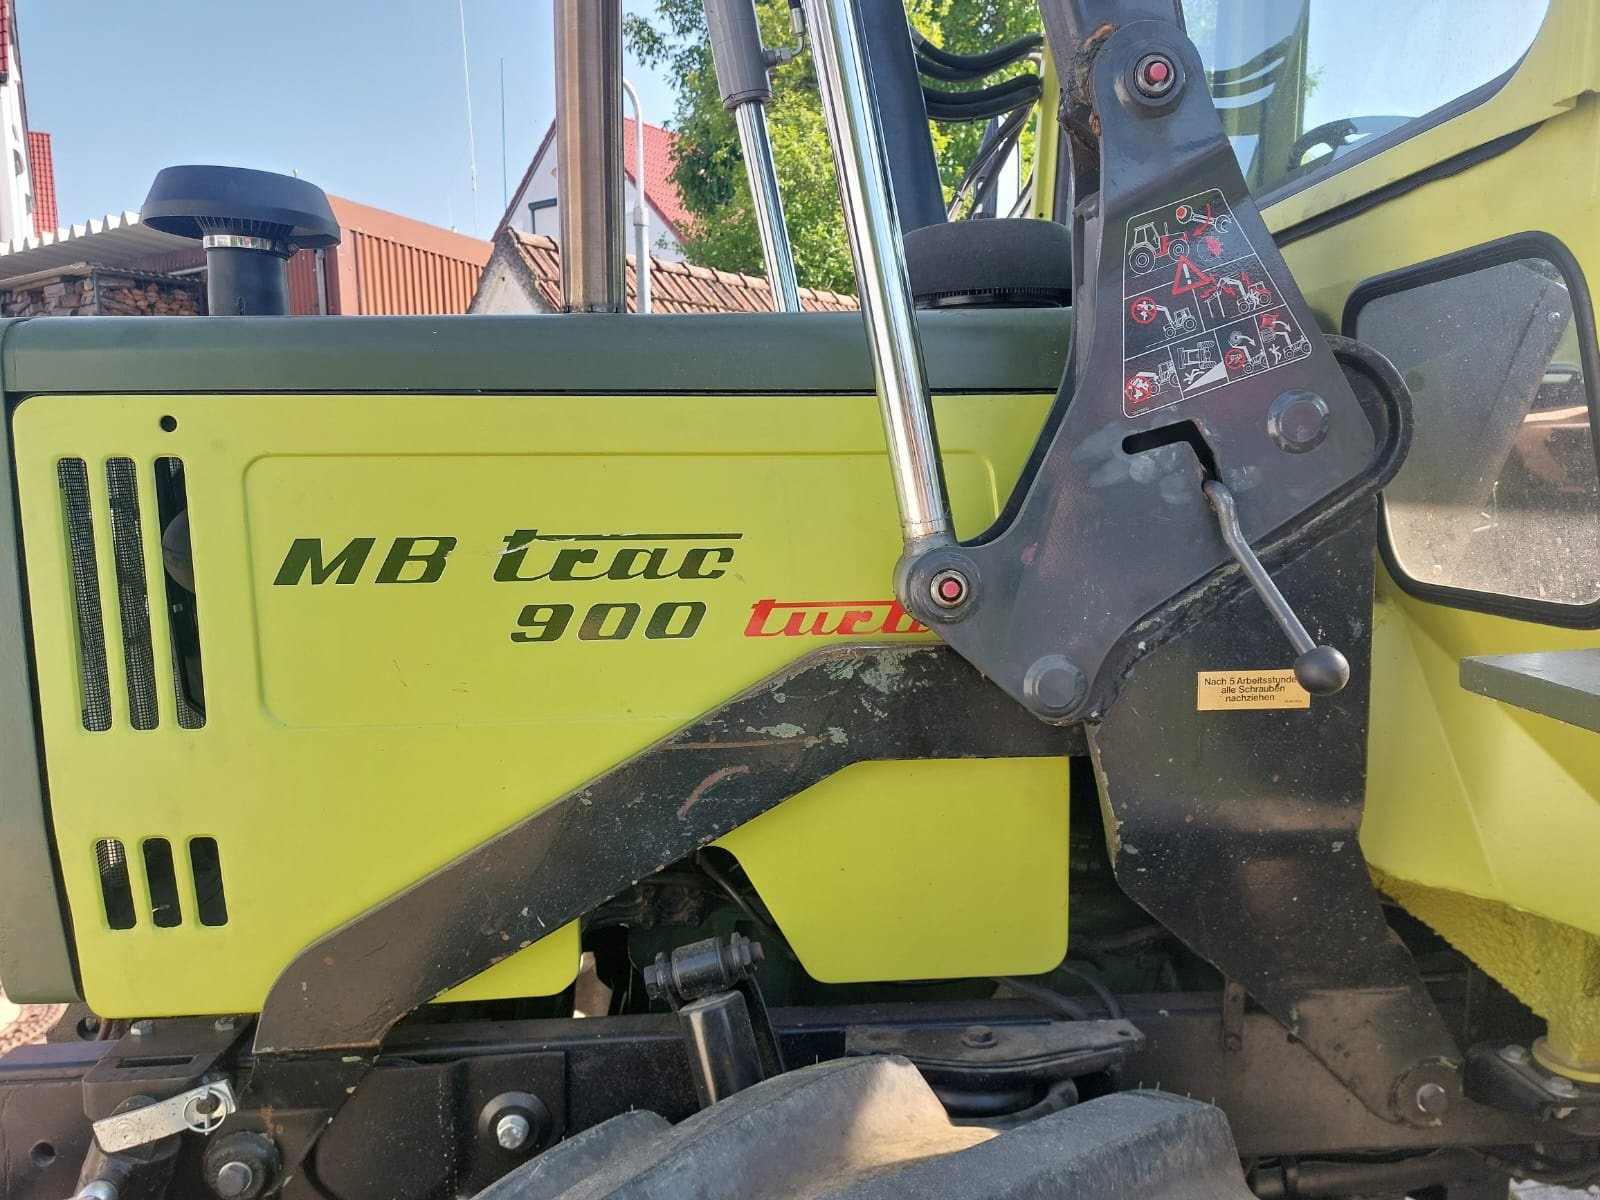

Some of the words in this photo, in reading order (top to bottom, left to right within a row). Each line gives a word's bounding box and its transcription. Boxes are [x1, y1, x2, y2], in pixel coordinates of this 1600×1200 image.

[273, 537, 457, 585] MB
[493, 529, 743, 582] trac
[511, 602, 706, 642] 900
[744, 598, 930, 637] turb
[1204, 677, 1227, 686] Nach
[1229, 677, 1235, 685] 5
[1236, 675, 1297, 685] Arbeitsstunde
[1220, 685, 1236, 694] alle
[1238, 684, 1286, 694] Schrauben
[1225, 693, 1275, 702] nachziehen
